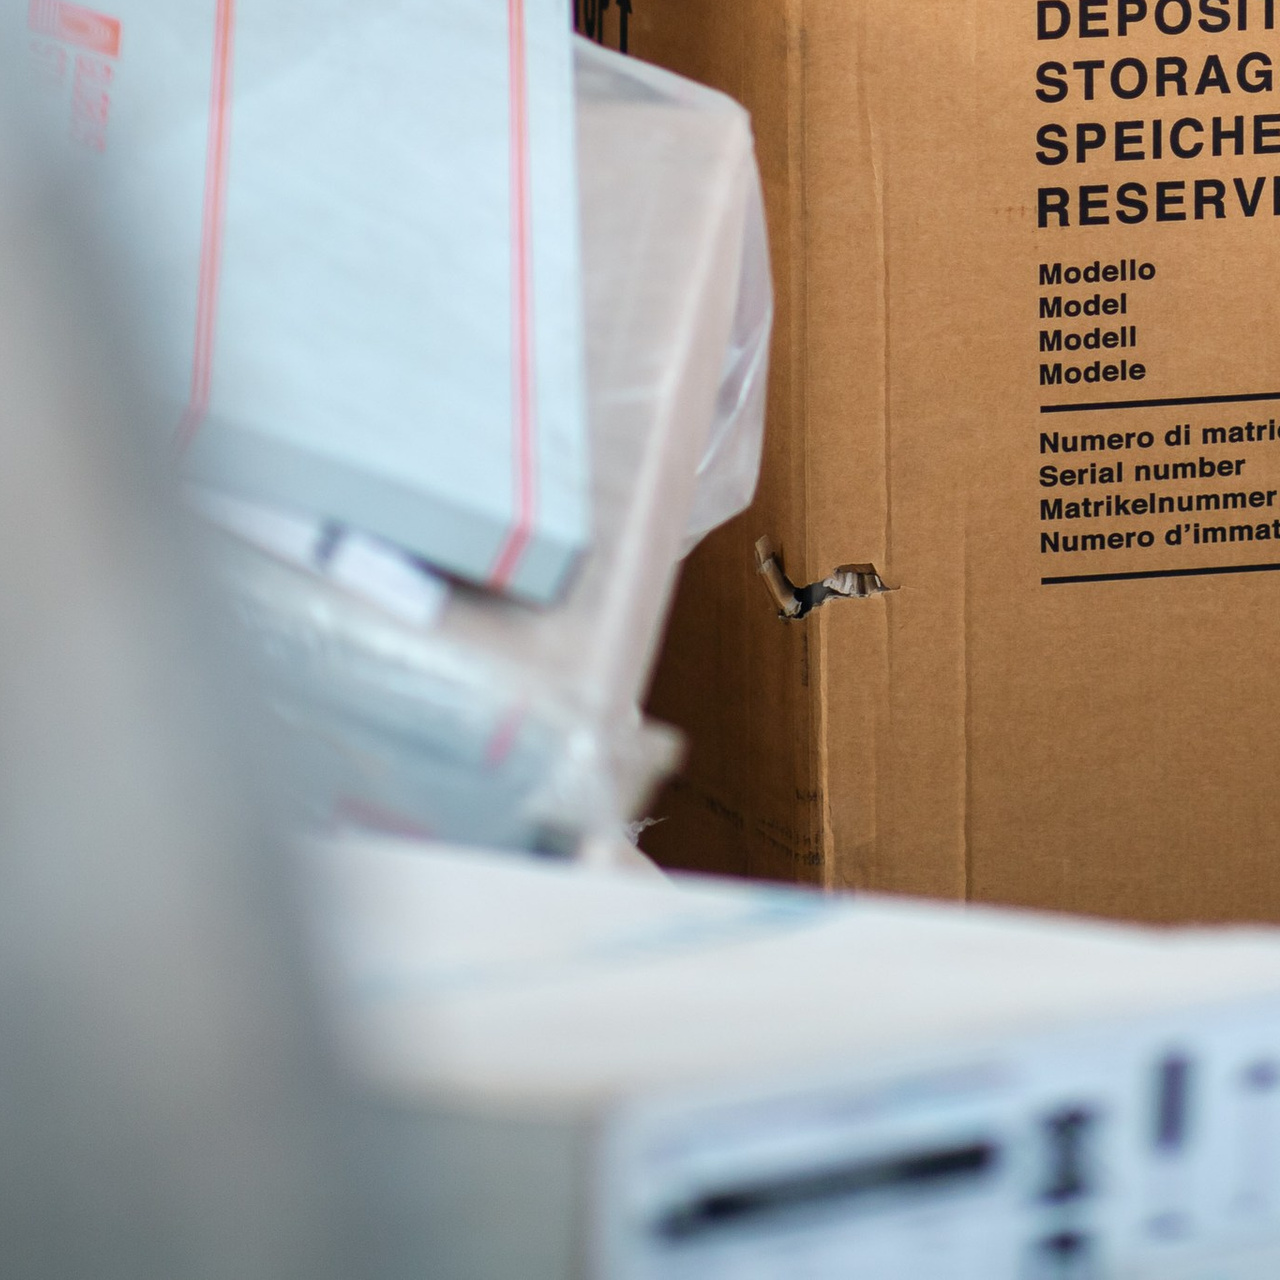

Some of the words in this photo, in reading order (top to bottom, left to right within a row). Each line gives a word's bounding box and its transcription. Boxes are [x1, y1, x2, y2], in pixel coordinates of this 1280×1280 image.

[1039, 258, 1156, 286] Modello
[1039, 292, 1127, 319] Model
[1039, 325, 1136, 352] Modell
[1039, 359, 1147, 386] Modele
[1039, 427, 1155, 454] Numero
[1164, 424, 1191, 447] di
[1039, 461, 1123, 488] Serial
[1134, 456, 1246, 482] number
[1039, 489, 1278, 521] Matrikelnummer
[1040, 528, 1155, 554] Numero
